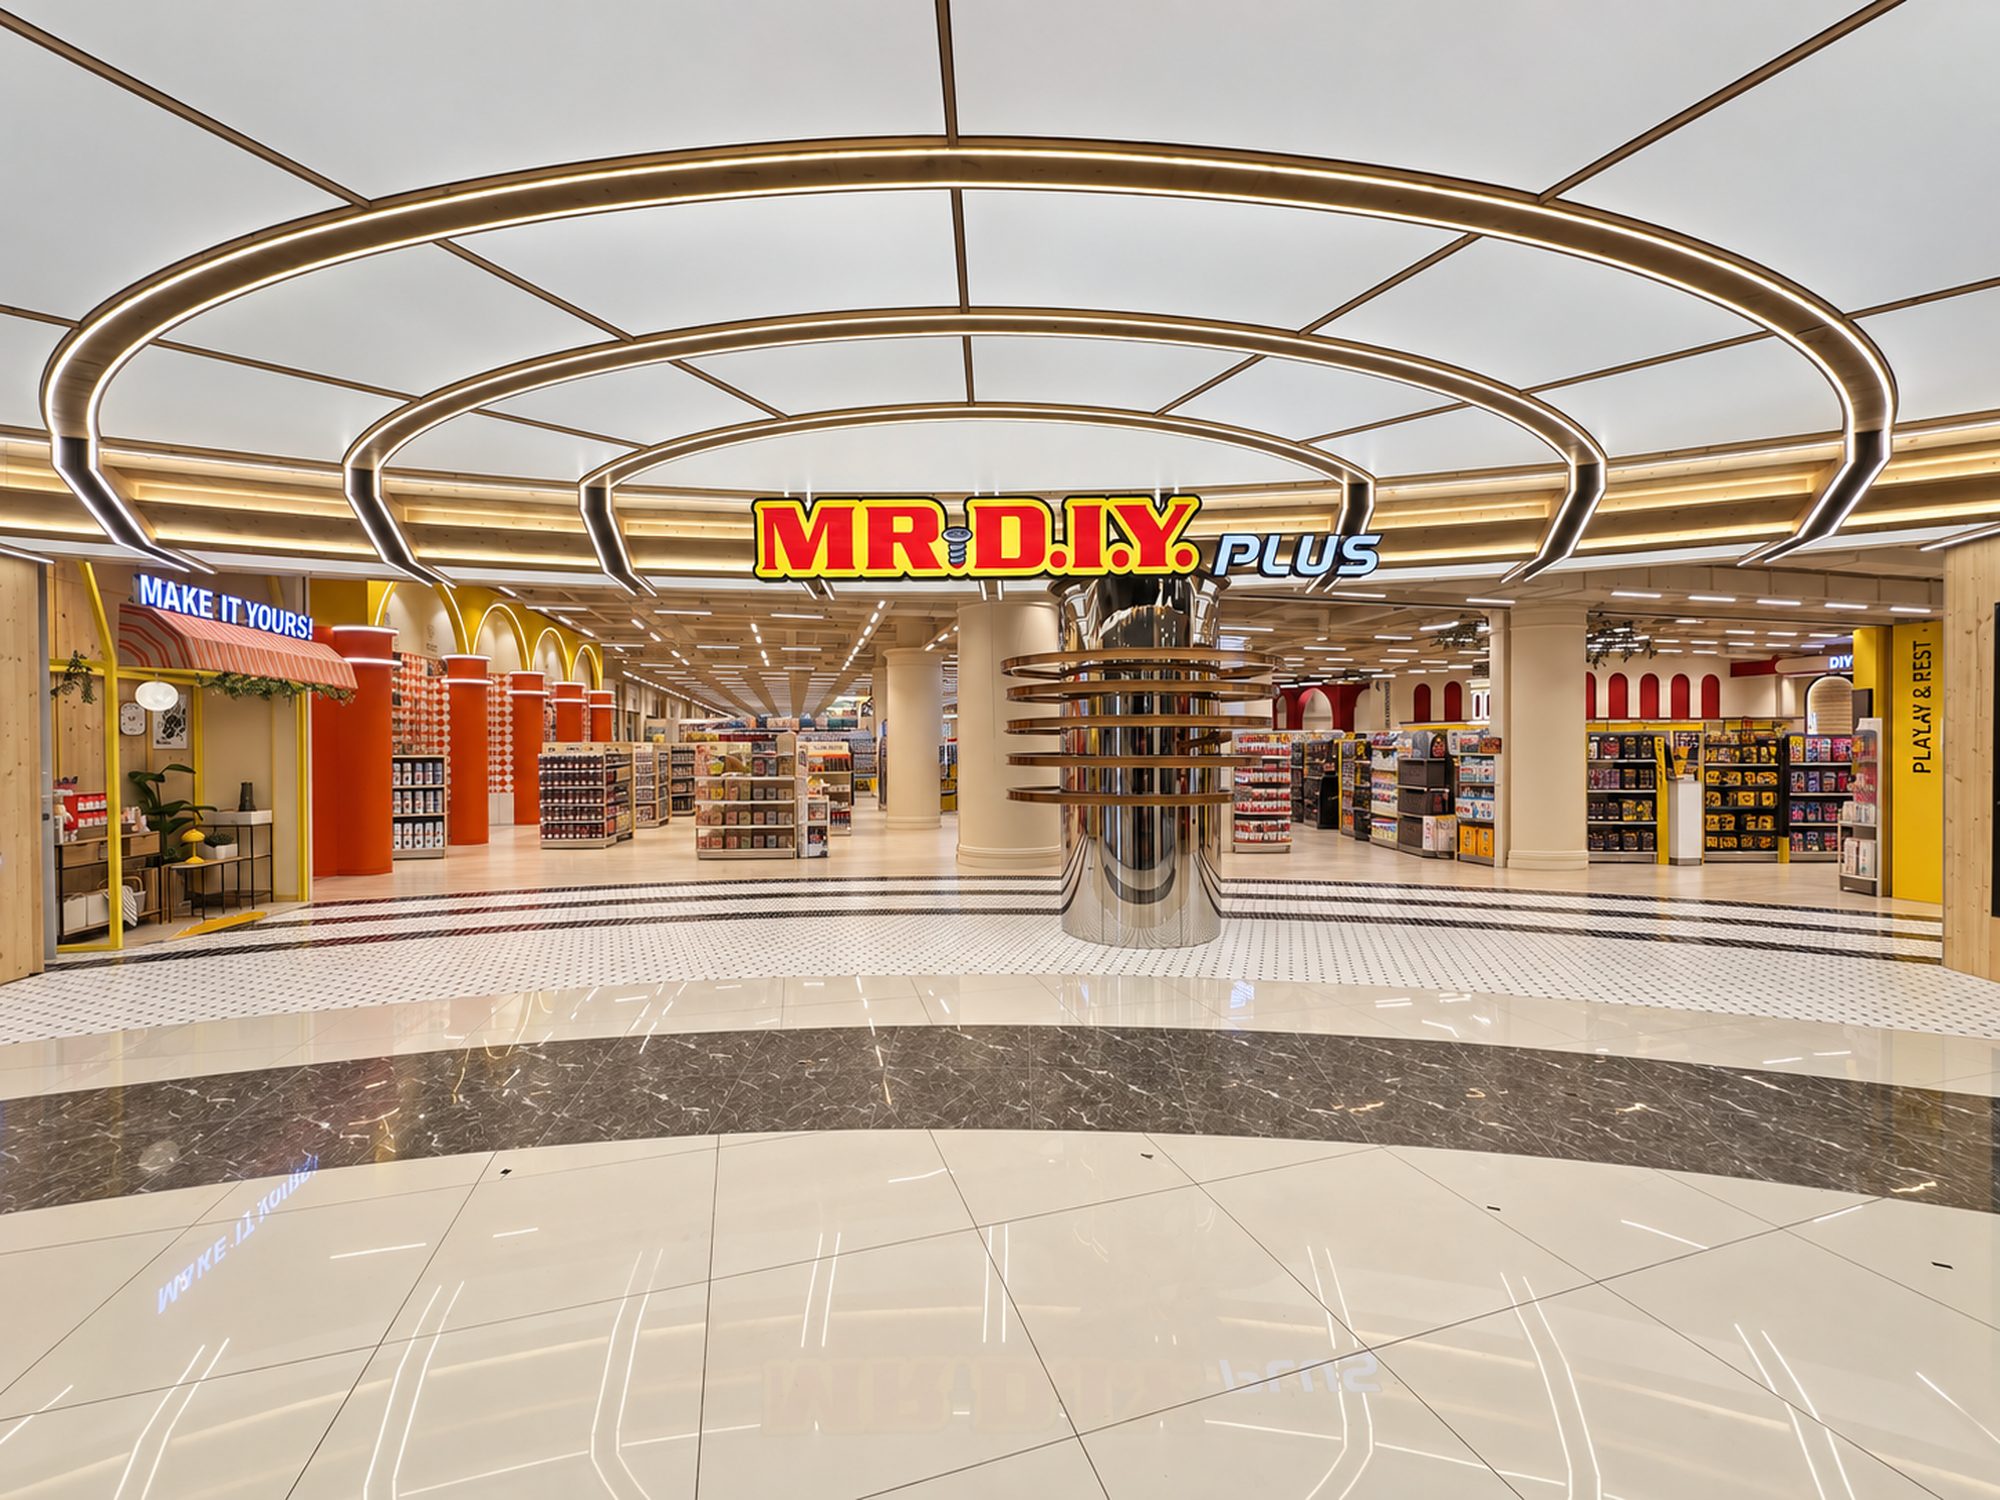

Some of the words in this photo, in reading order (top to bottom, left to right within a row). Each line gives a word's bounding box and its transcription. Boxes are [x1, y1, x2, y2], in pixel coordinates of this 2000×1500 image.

[1213, 533, 1382, 577] PLUS
[139, 574, 215, 619] MAKE
[220, 594, 243, 625] IT
[245, 600, 314, 641] YOURS!
[1829, 655, 1854, 669] DIY
[1912, 640, 1932, 682] REST
[1912, 686, 1932, 698] &
